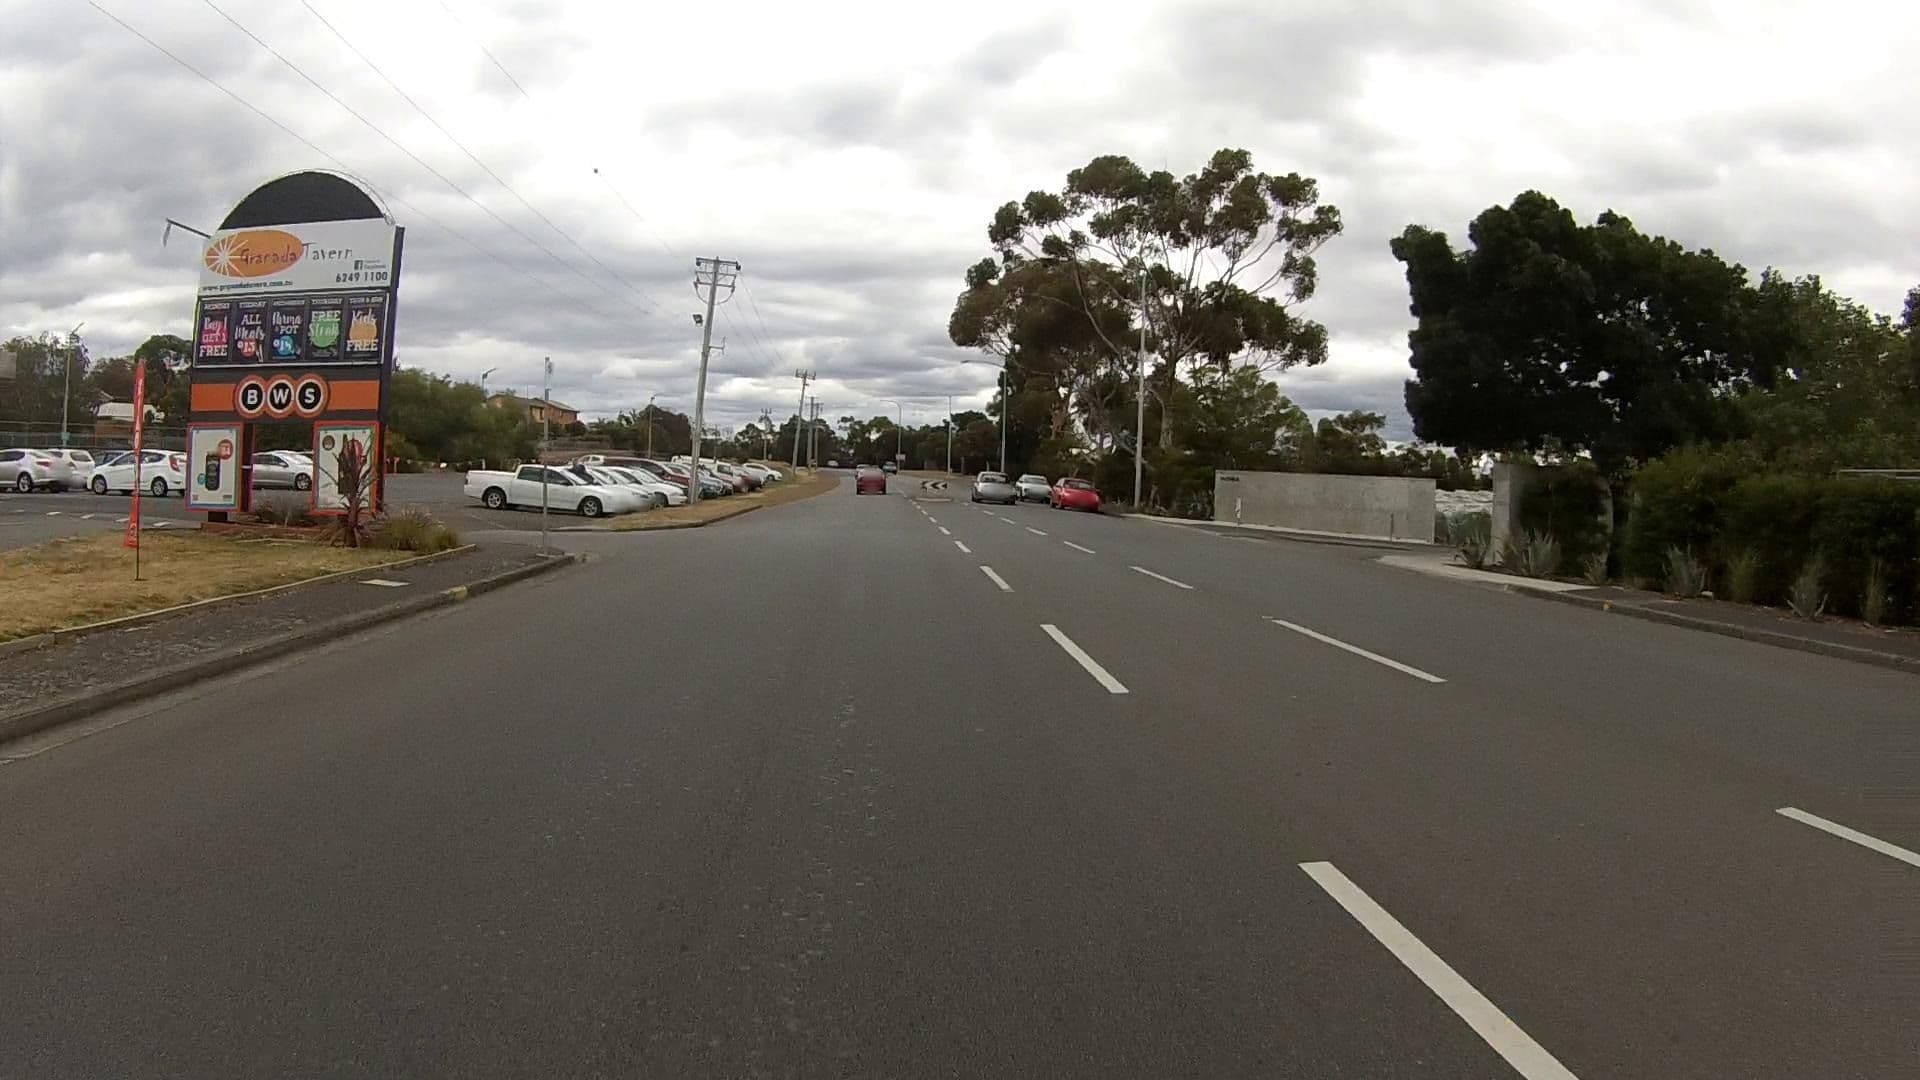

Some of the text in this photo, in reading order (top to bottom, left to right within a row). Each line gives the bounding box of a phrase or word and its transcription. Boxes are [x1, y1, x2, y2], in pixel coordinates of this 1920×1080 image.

[302, 242, 353, 261] Tavern
[336, 271, 388, 282] 6249 1100
[241, 314, 262, 325] ALL
[311, 310, 340, 321] FREE
[352, 308, 377, 326] Kids
[279, 325, 299, 335] POT
[199, 345, 228, 357] FREE
[346, 339, 379, 352] FREE
[246, 388, 315, 405] BWS
